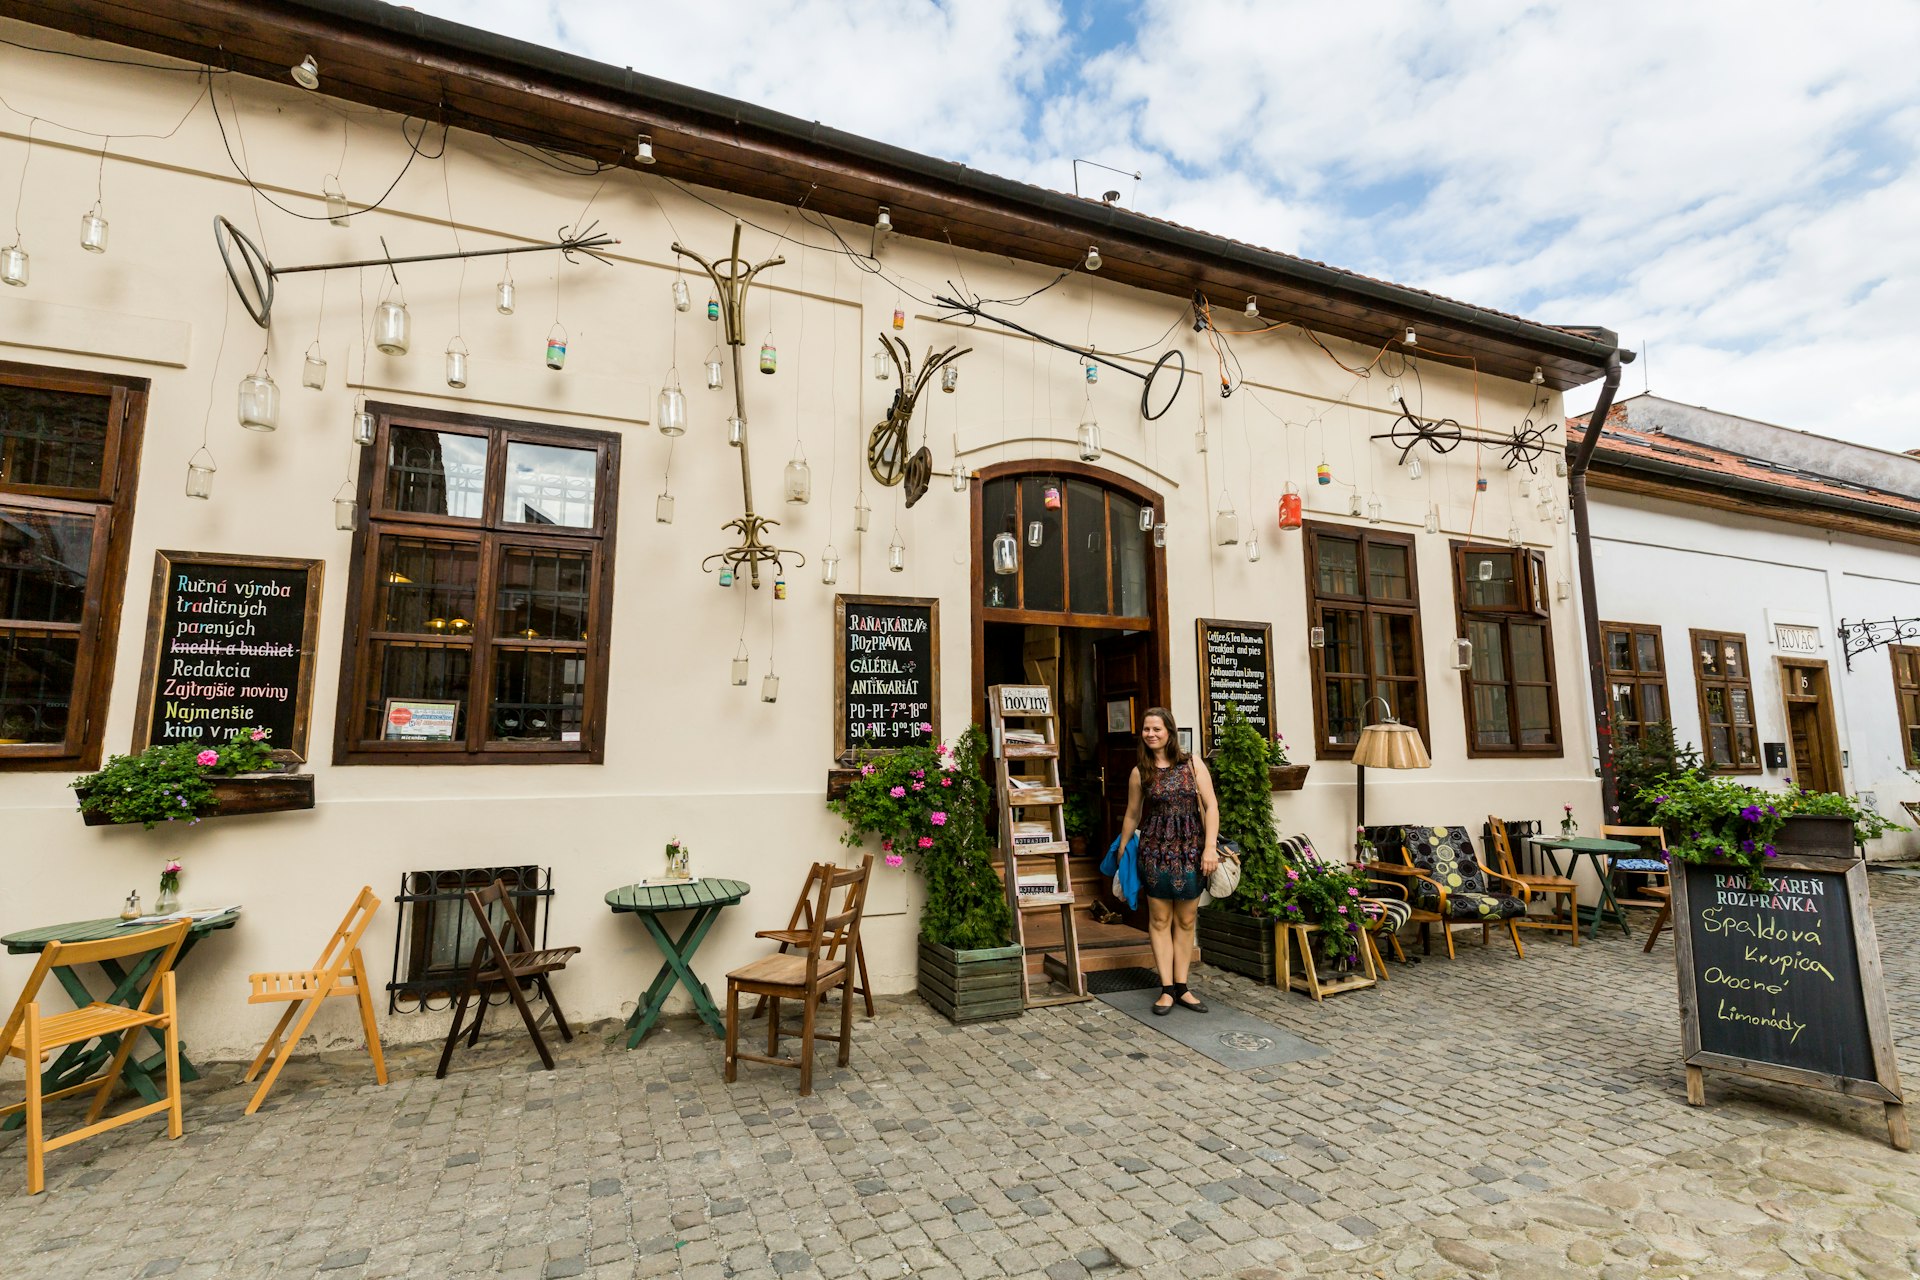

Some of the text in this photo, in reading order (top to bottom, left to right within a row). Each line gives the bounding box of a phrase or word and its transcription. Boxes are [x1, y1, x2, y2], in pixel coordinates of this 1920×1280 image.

[177, 575, 291, 598] Ručná výroba
[177, 596, 267, 618] tradičných
[176, 619, 255, 638] parených
[226, 643, 236, 655] a
[850, 634, 912, 653] ROZPRÁVKA
[1208, 642, 1261, 656] breakfast and pies
[1780, 629, 1815, 650] KOVÁČ
[172, 659, 251, 677] Redakcia
[1210, 654, 1238, 670] Gallery
[163, 679, 289, 701] Zajtrajšie noviny
[1801, 676, 1809, 689] 15
[165, 701, 254, 722] Najmenšie
[1004, 696, 1048, 713] noviny
[1213, 701, 1226, 711] The
[163, 721, 203, 738] kino
[210, 726, 221, 738] v
[1716, 891, 1819, 913] ROZPRÁVKA
[1702, 906, 1822, 946] Špaldová
[1745, 945, 1835, 982] Krupica
[1704, 966, 1789, 994] Ovocné
[1718, 998, 1806, 1045] Limonády
